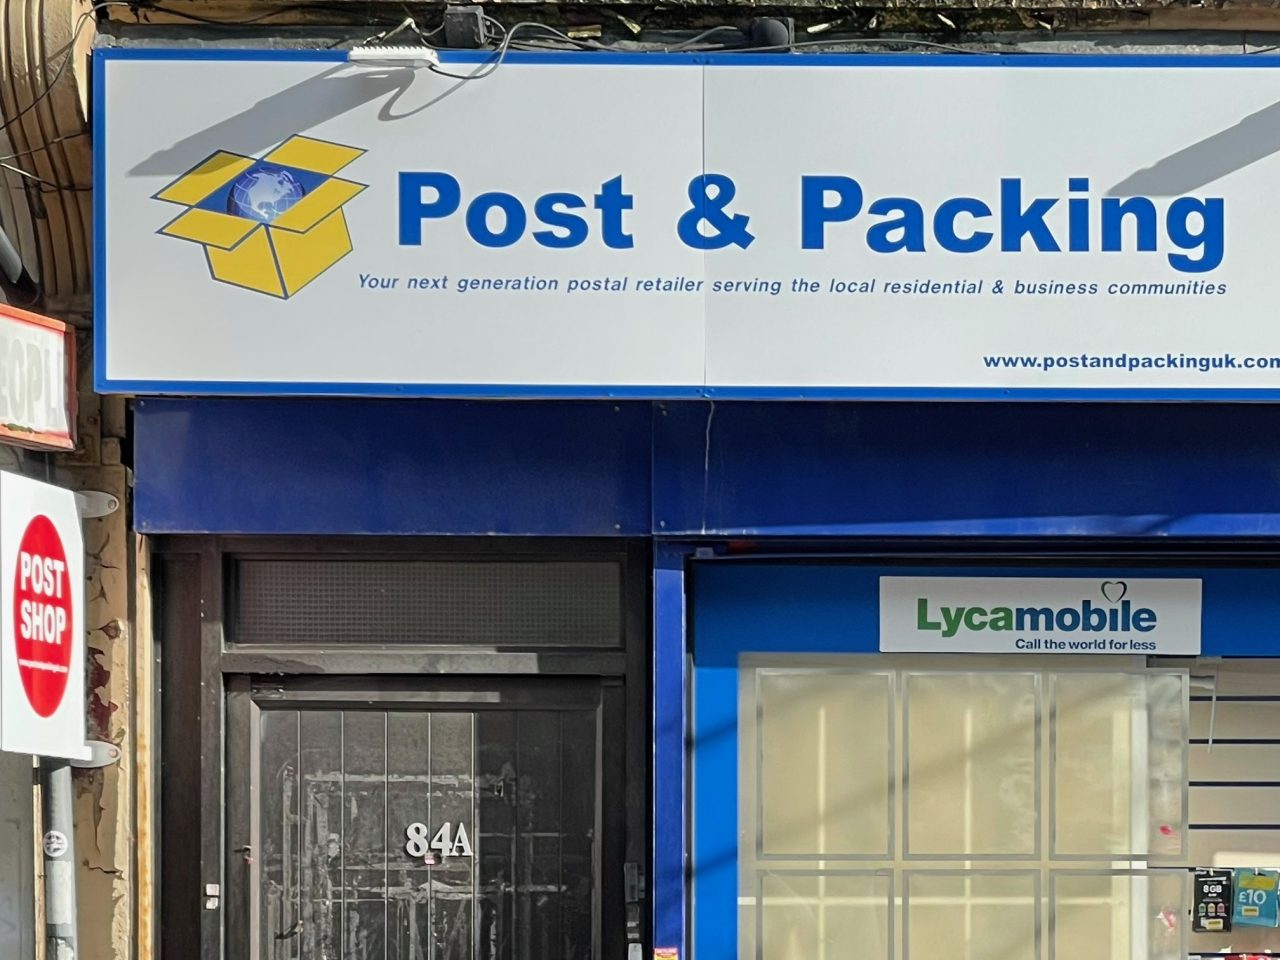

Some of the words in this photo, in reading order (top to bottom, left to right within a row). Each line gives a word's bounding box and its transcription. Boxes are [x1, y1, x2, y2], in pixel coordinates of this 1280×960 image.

[398, 171, 635, 249] Post
[677, 173, 755, 250] &
[801, 174, 1225, 274] Packing
[358, 274, 398, 290] Your
[407, 275, 447, 290] next
[457, 274, 558, 293] generation
[567, 275, 628, 295] postal
[635, 276, 703, 293] retailer
[712, 278, 781, 295] serving
[791, 278, 820, 293] the
[829, 278, 875, 293] local
[883, 279, 983, 295] residential
[992, 280, 1004, 294] &
[1014, 279, 1098, 295] business
[1108, 280, 1227, 296] communities
[20, 551, 64, 599] POST
[20, 599, 66, 645] SHOP
[917, 598, 1157, 637] Lycamobile
[1015, 638, 1041, 650] Call
[1044, 638, 1066, 650] the
[1068, 639, 1106, 651] world
[1109, 639, 1128, 651] for
[1129, 640, 1157, 651] less
[406, 822, 473, 857] 84A
[1203, 885, 1222, 893] 8GB
[1239, 889, 1267, 905] £10
